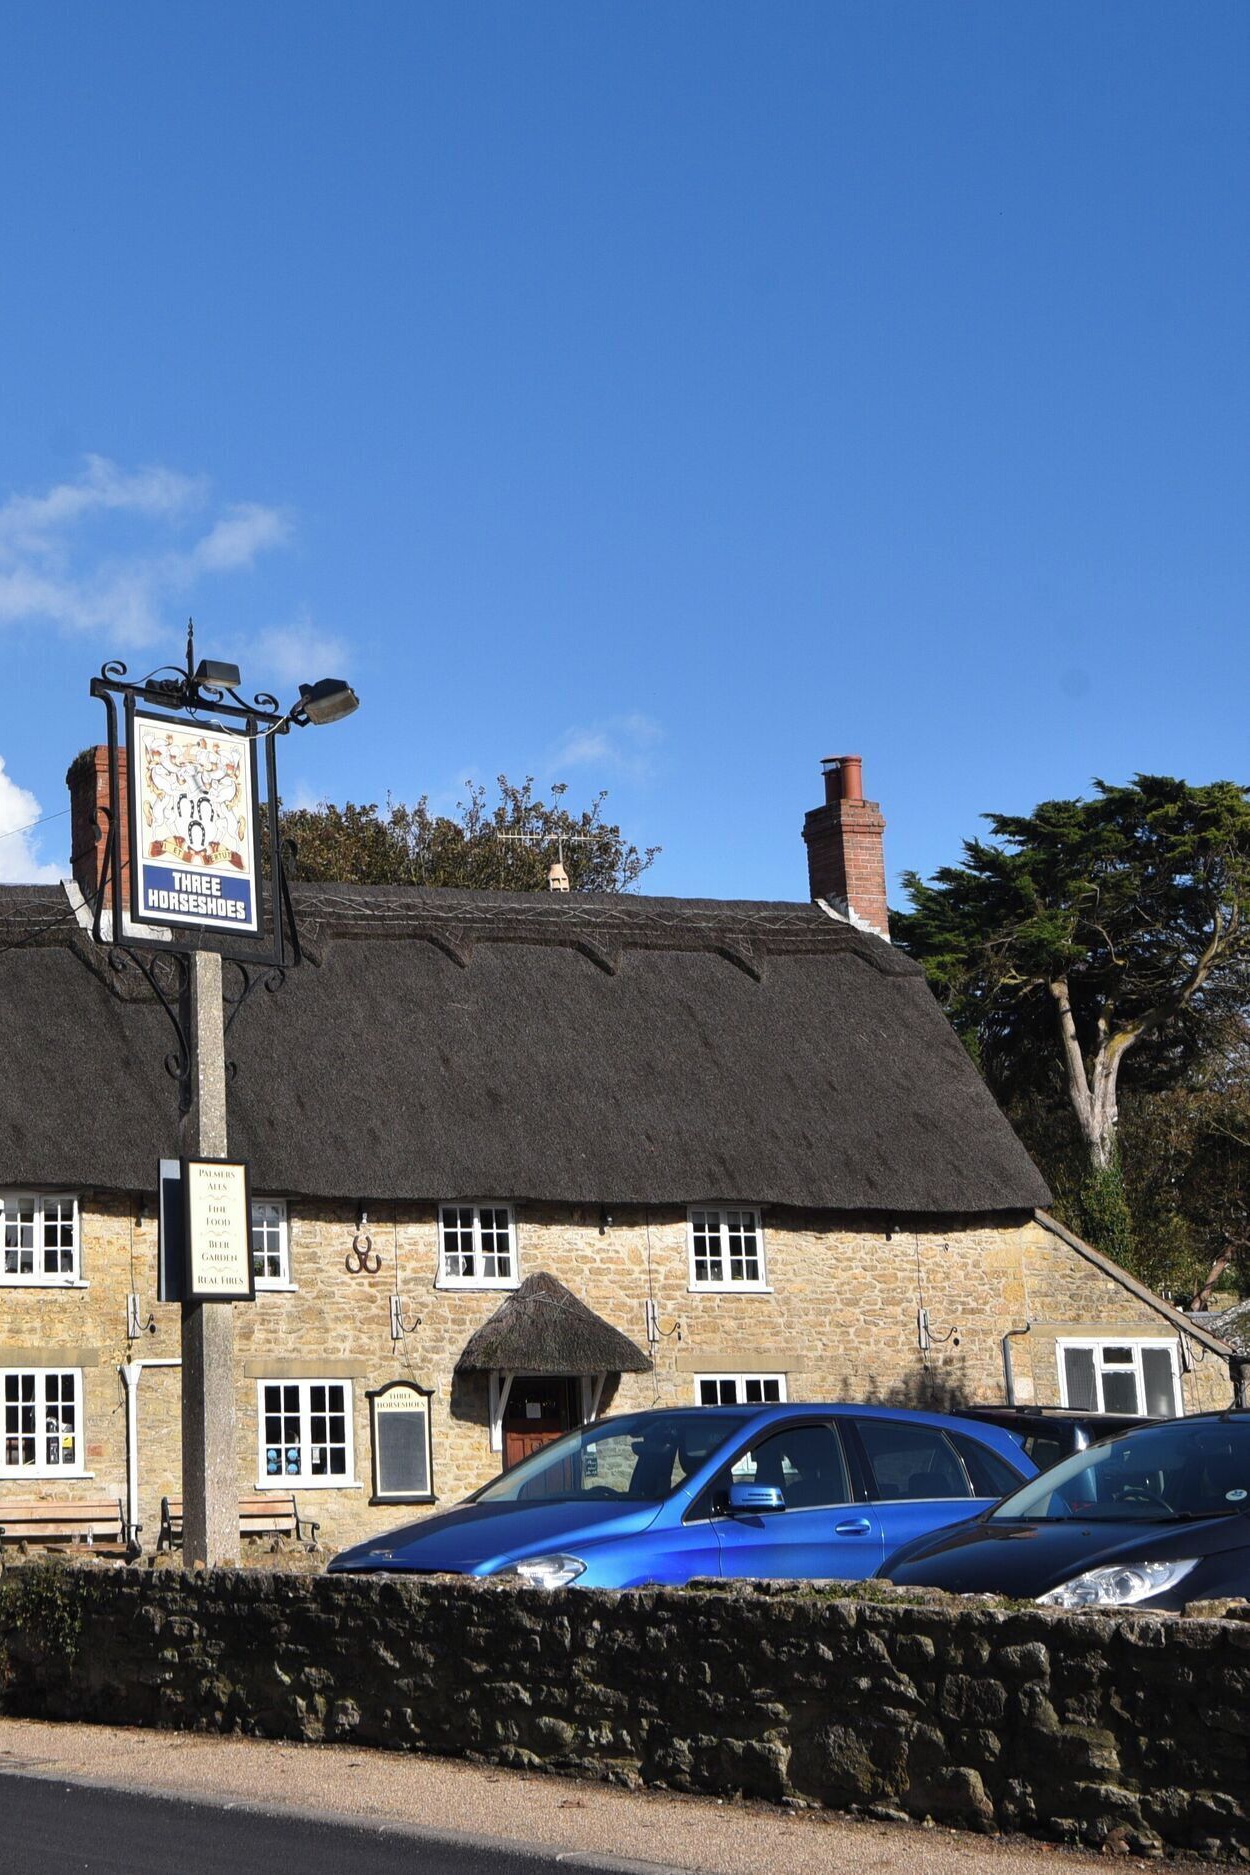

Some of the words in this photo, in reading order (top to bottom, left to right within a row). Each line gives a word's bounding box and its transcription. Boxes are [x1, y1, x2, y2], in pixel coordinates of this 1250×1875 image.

[172, 872, 222, 897] THREE
[148, 888, 246, 920] HORSESHOES
[199, 1168, 236, 1178] PALMERS
[208, 1182, 227, 1191] ALES
[208, 1204, 226, 1213] FINE
[206, 1217, 231, 1227] FOOD
[209, 1240, 229, 1249] BEER
[201, 1252, 238, 1262] GARDEN
[197, 1275, 219, 1285] REAL
[221, 1275, 244, 1285] FIRES
[376, 1401, 426, 1409] HORSESHOES
